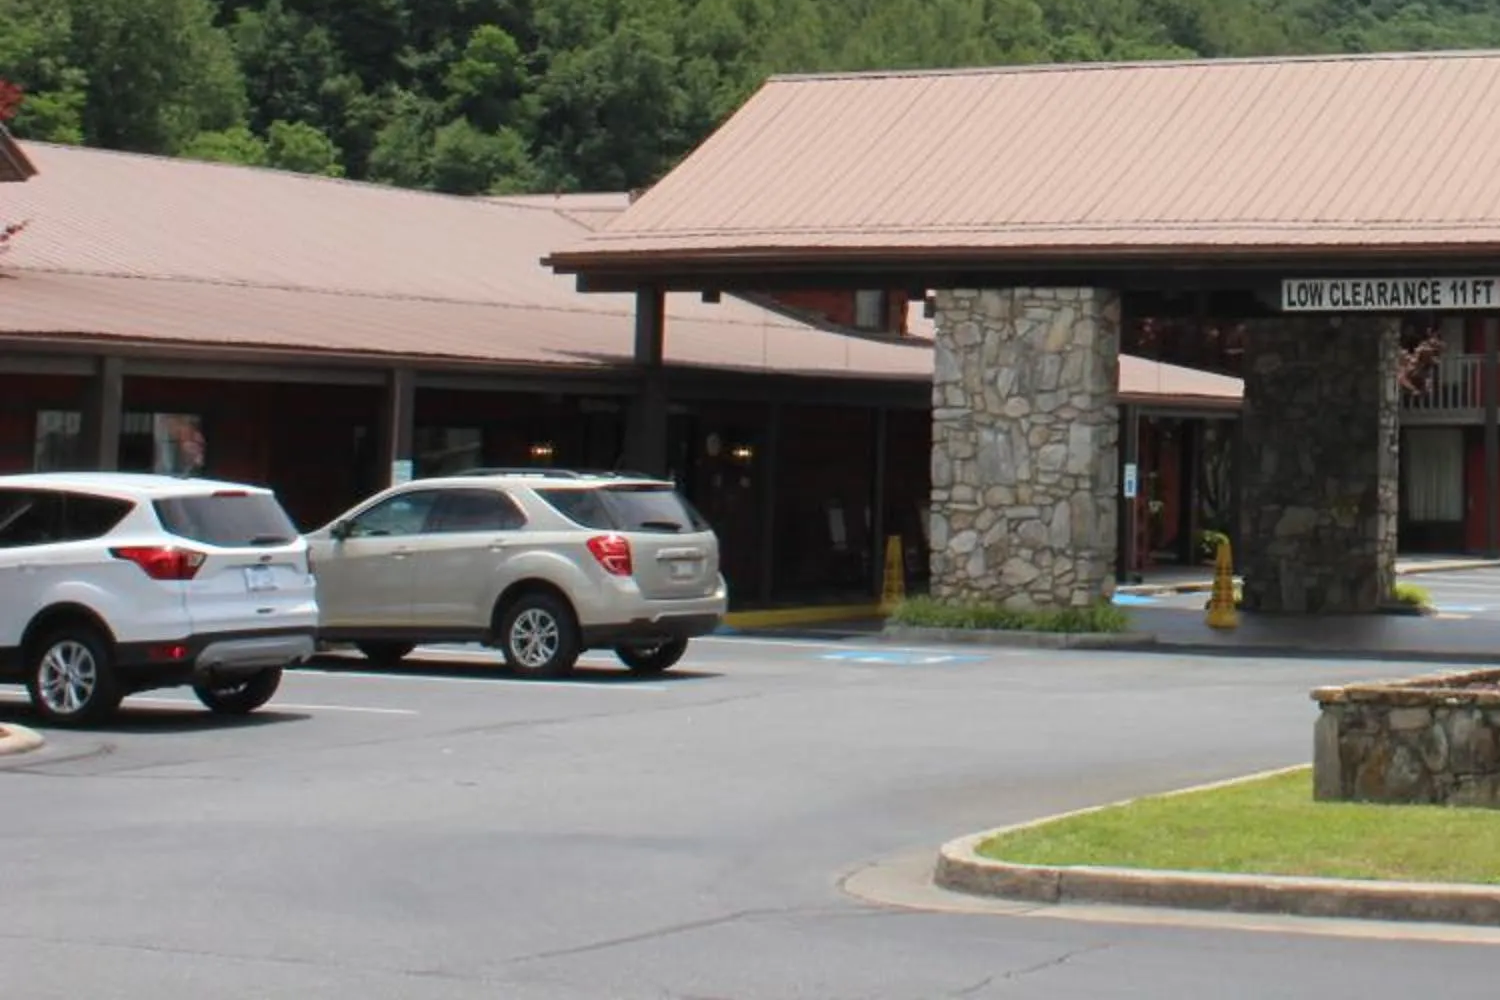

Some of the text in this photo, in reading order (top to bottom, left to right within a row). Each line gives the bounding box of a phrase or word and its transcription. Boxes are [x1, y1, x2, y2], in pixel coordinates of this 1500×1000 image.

[1287, 281, 1323, 307] LOW
[1329, 281, 1441, 307] CLEARANCE
[1450, 280, 1467, 305] 11
[1472, 280, 1495, 305] FT
